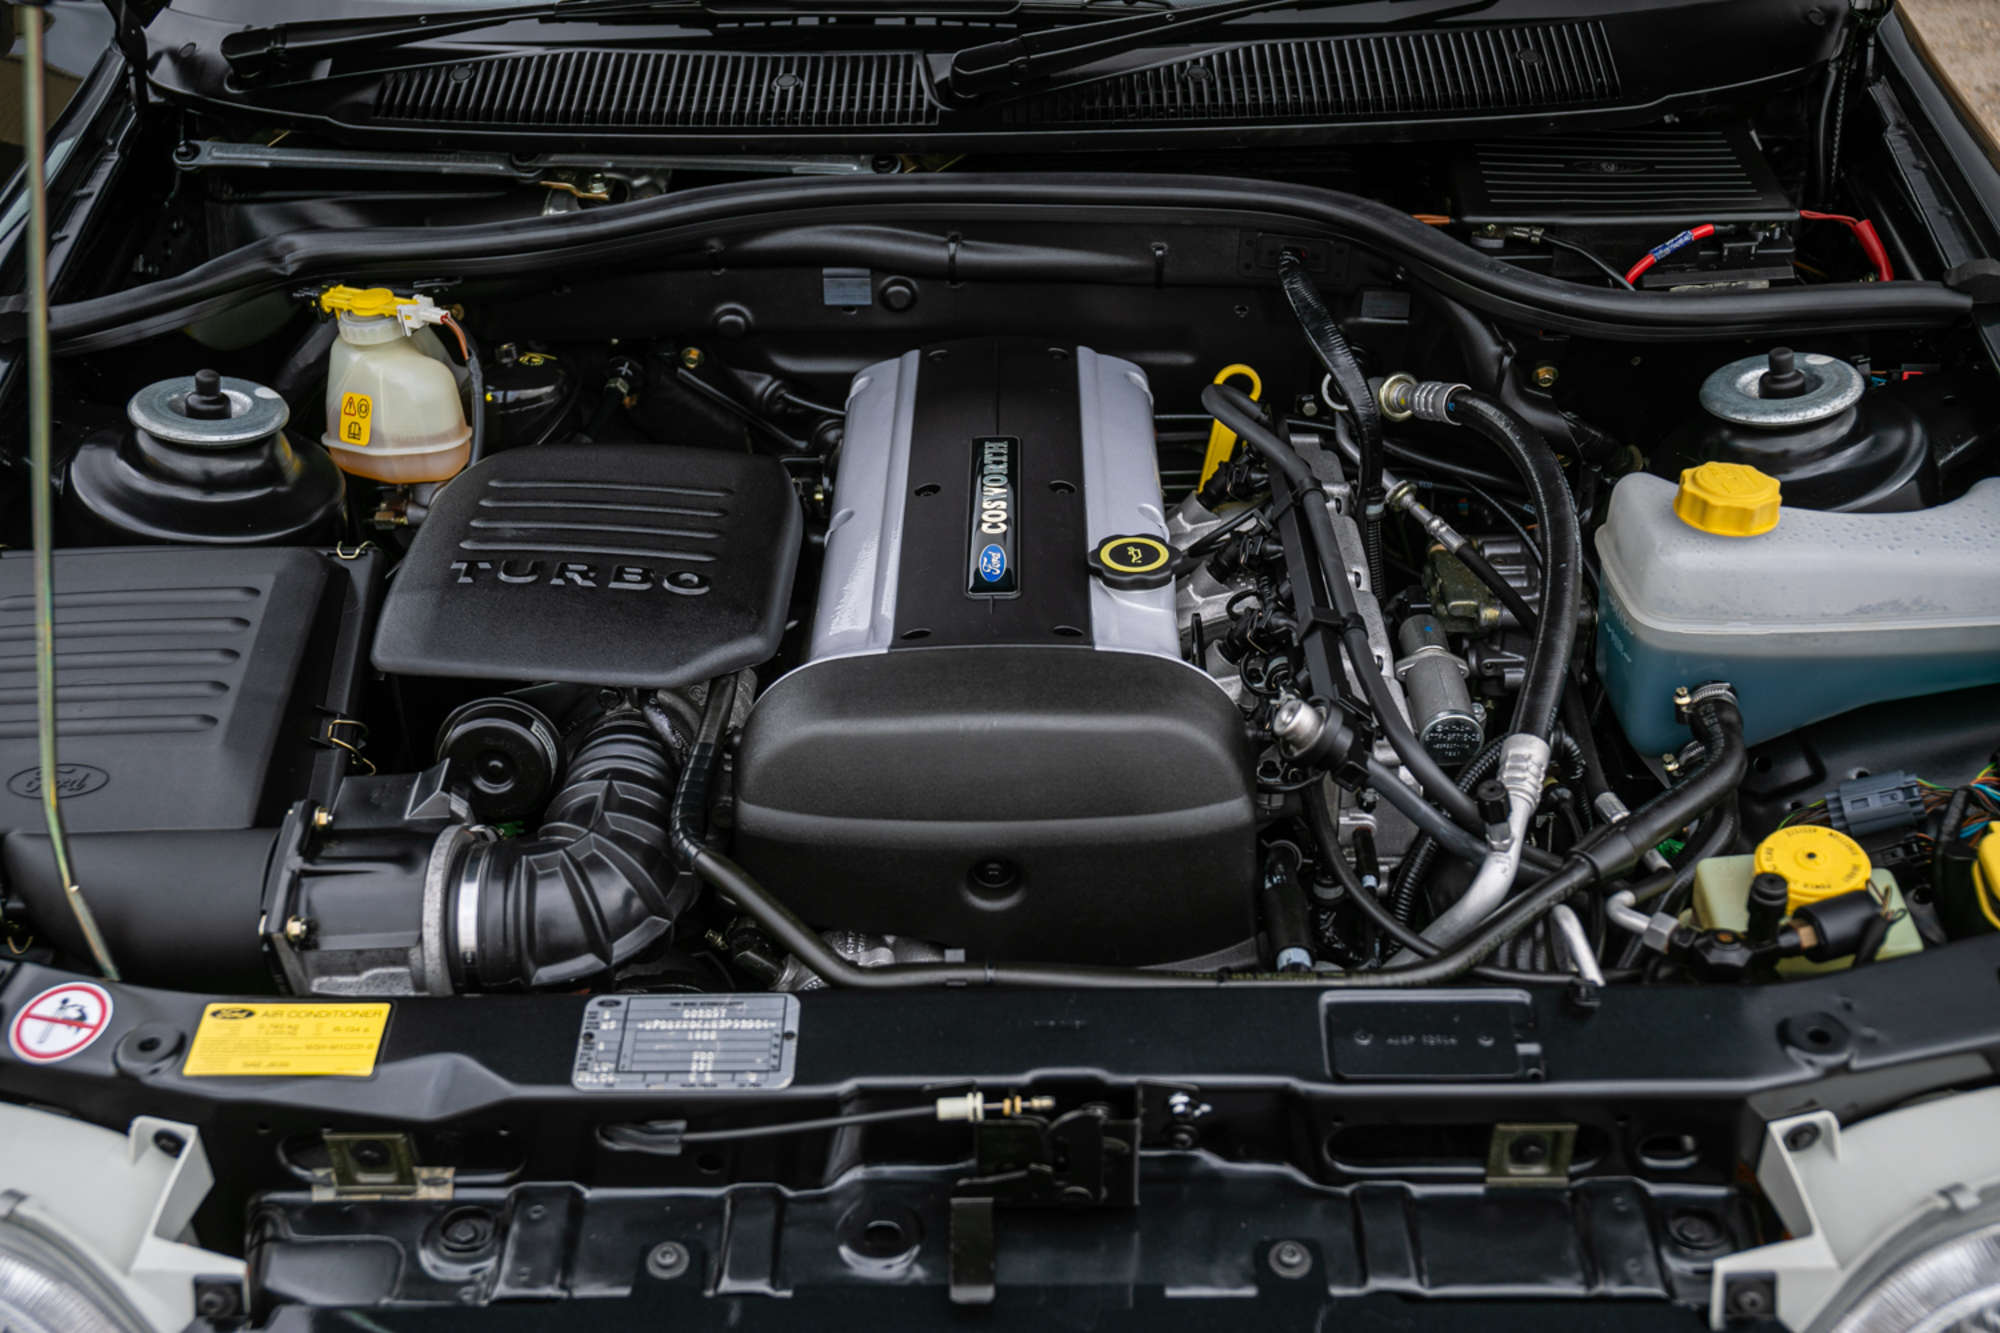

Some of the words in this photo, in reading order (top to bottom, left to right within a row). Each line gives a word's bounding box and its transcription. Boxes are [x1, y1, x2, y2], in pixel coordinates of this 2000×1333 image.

[980, 441, 1008, 534] COSWORTH
[450, 560, 712, 595] TURBO
[286, 1009, 382, 1018] CONDITIONER
